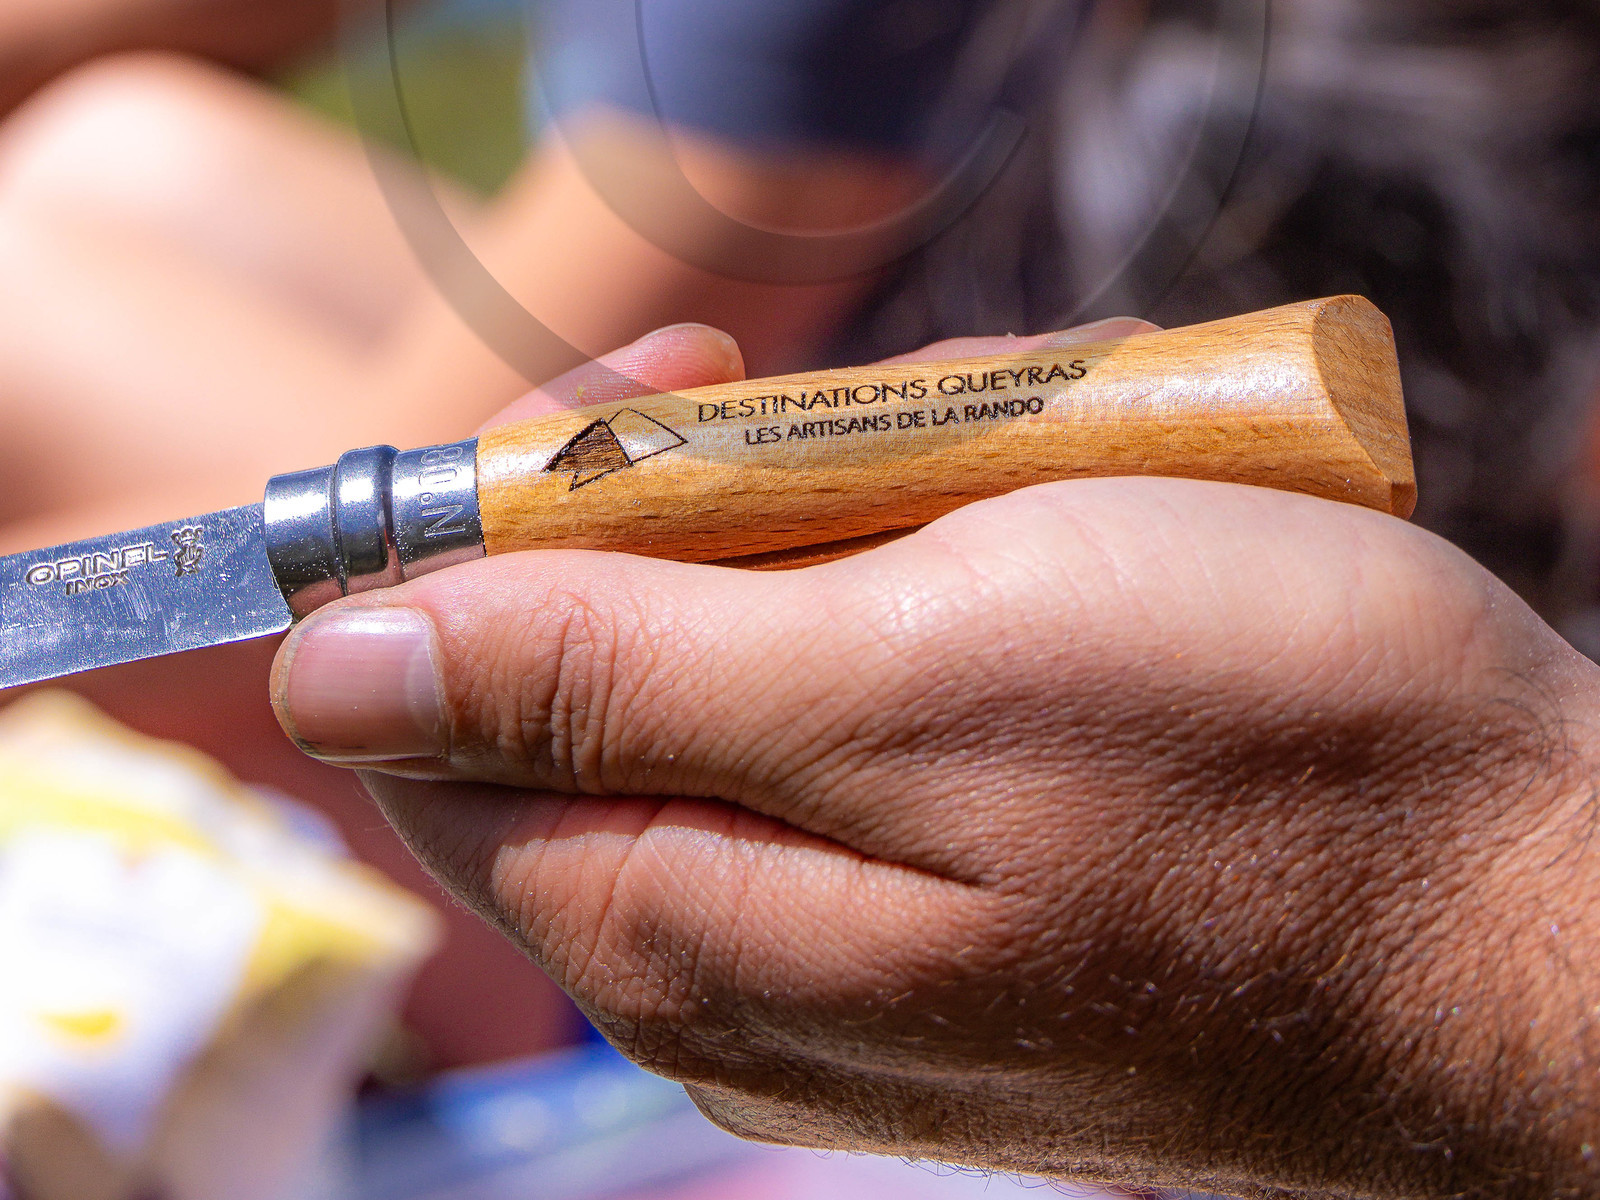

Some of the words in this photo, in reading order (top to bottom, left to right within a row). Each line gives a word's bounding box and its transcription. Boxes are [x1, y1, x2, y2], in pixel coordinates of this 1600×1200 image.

[698, 379, 928, 423] DESTINATIONS
[937, 360, 1088, 396] QUEYRAS
[745, 425, 782, 446] LES
[787, 413, 893, 442] ARTISANS
[897, 410, 926, 430] DE
[931, 406, 960, 427] LA
[964, 396, 1045, 423] RANDO
[25, 541, 169, 586] OPINEL
[66, 568, 130, 596] INOX
